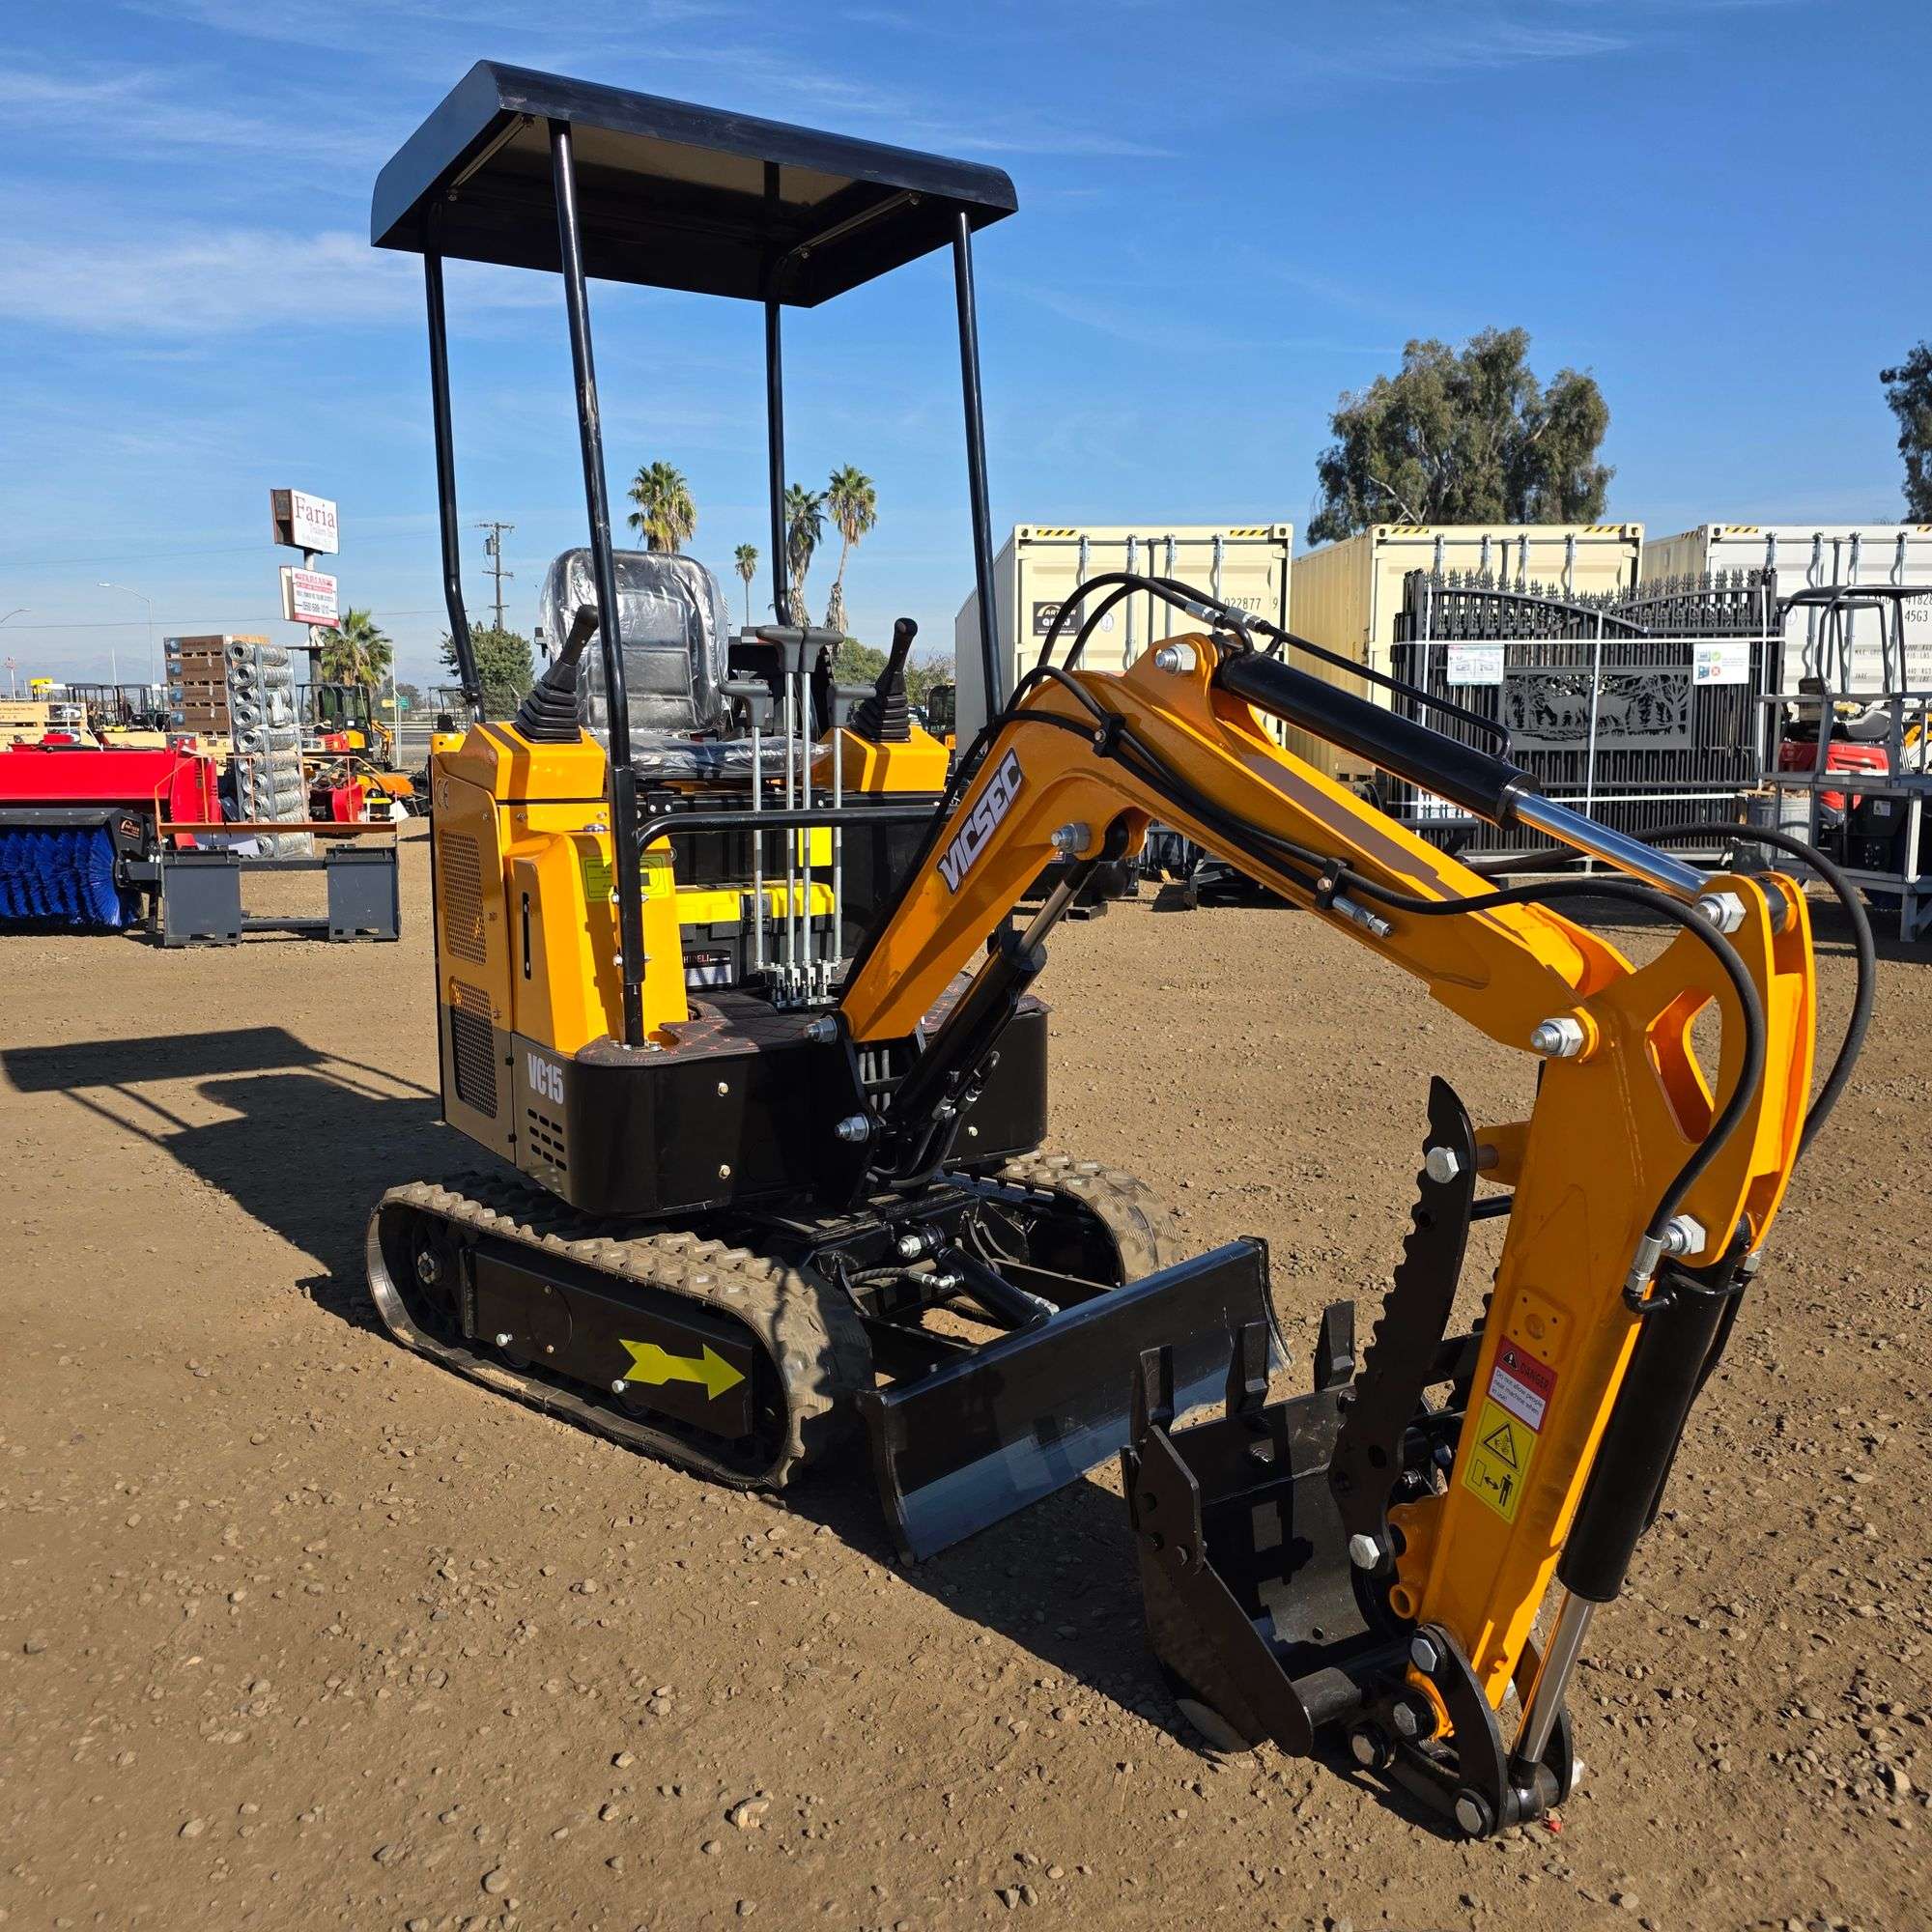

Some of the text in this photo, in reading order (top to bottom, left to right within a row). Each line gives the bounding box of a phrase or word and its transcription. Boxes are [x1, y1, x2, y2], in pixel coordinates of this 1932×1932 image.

[294, 495, 335, 528] Faria
[1224, 597, 1279, 611] 022877 9
[1905, 611, 1928, 622] 45G3
[938, 751, 1022, 892] VICSEC
[527, 1053, 564, 1104] VC15
[1520, 1362, 1549, 1391] DANGER
